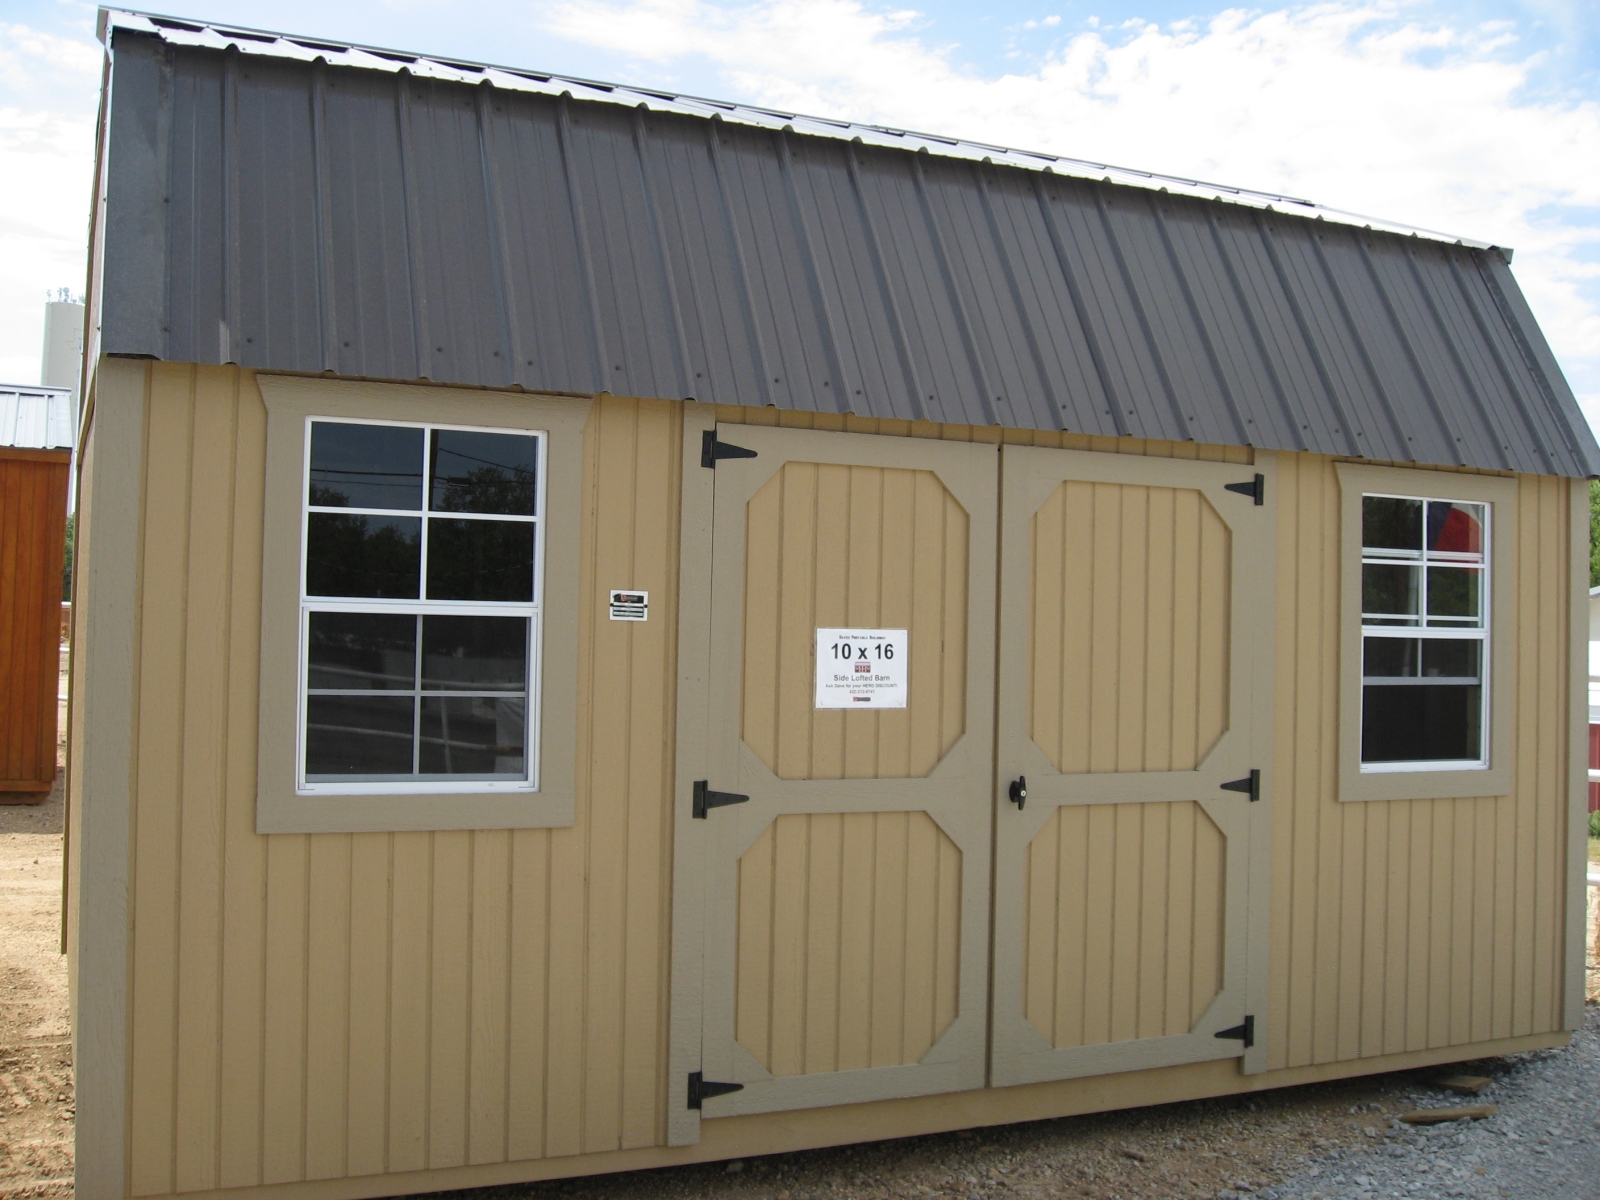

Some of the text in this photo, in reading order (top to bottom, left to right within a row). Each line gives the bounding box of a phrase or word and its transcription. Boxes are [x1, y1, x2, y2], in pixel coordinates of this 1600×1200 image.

[831, 643, 894, 660] 10 x 16
